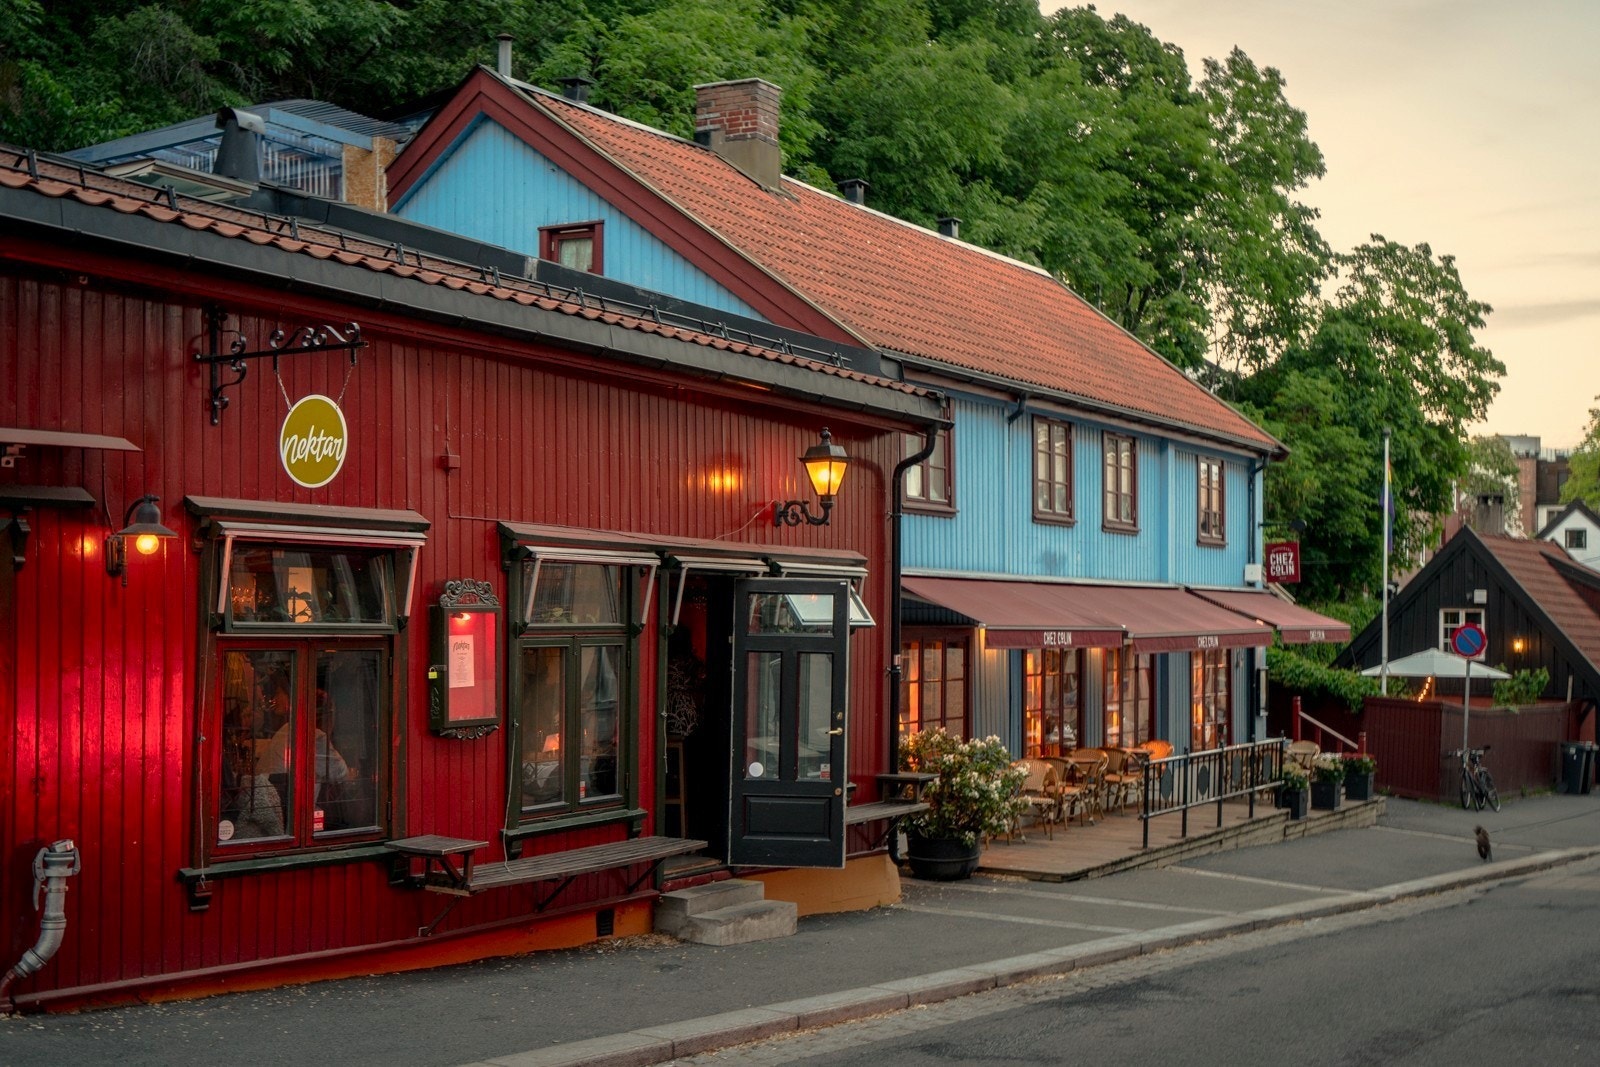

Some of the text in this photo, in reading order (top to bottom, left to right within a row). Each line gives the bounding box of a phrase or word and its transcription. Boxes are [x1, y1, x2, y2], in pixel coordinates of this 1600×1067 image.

[1270, 552, 1294, 565] CHEZ
[1270, 564, 1295, 576] COLIN
[1043, 631, 1072, 645] CHEZ COLIN
